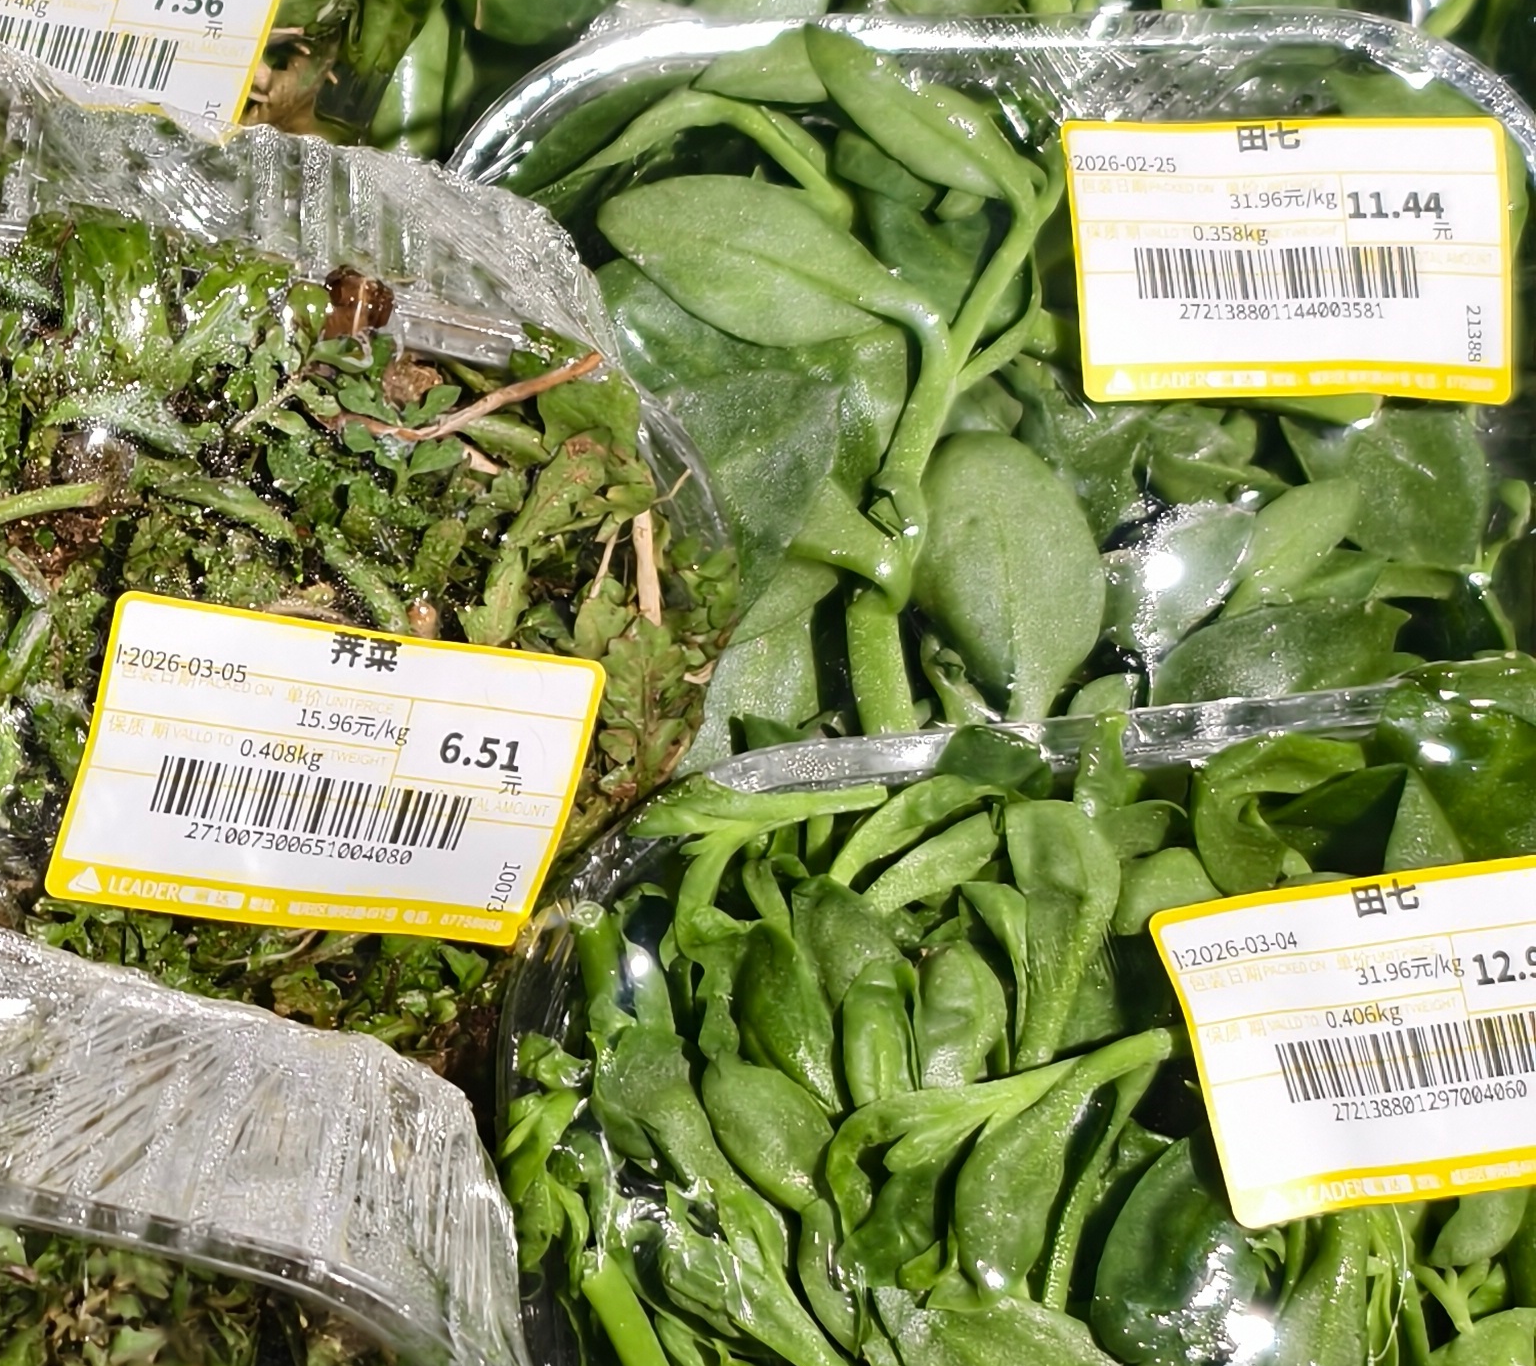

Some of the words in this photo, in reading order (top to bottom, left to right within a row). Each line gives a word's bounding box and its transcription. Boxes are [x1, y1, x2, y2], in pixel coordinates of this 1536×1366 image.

[202, 20, 223, 40] 元
[1236, 122, 1301, 153] 田七
[1230, 189, 1337, 210] 31.96元/kg
[1347, 191, 1445, 220] 11.44
[1193, 225, 1269, 246] 0.358kg
[1433, 222, 1453, 241] 元
[1180, 303, 1384, 321] 272138801144003581
[1466, 305, 1482, 363] 21388
[330, 632, 402, 673] 荠菜
[297, 708, 411, 747] 15.96元/kg
[240, 737, 324, 772] 0.408kg
[439, 731, 521, 773] 6.51
[500, 774, 522, 797] 元
[185, 822, 412, 865] 271007300651004080
[108, 875, 180, 903] LEADER
[487, 860, 522, 913] 10073
[1351, 878, 1420, 918] 田七
[1356, 956, 1465, 987] 31.96元/kg
[1326, 1002, 1403, 1030] 0.406kg
[1334, 1081, 1527, 1122] 272138801297004060
